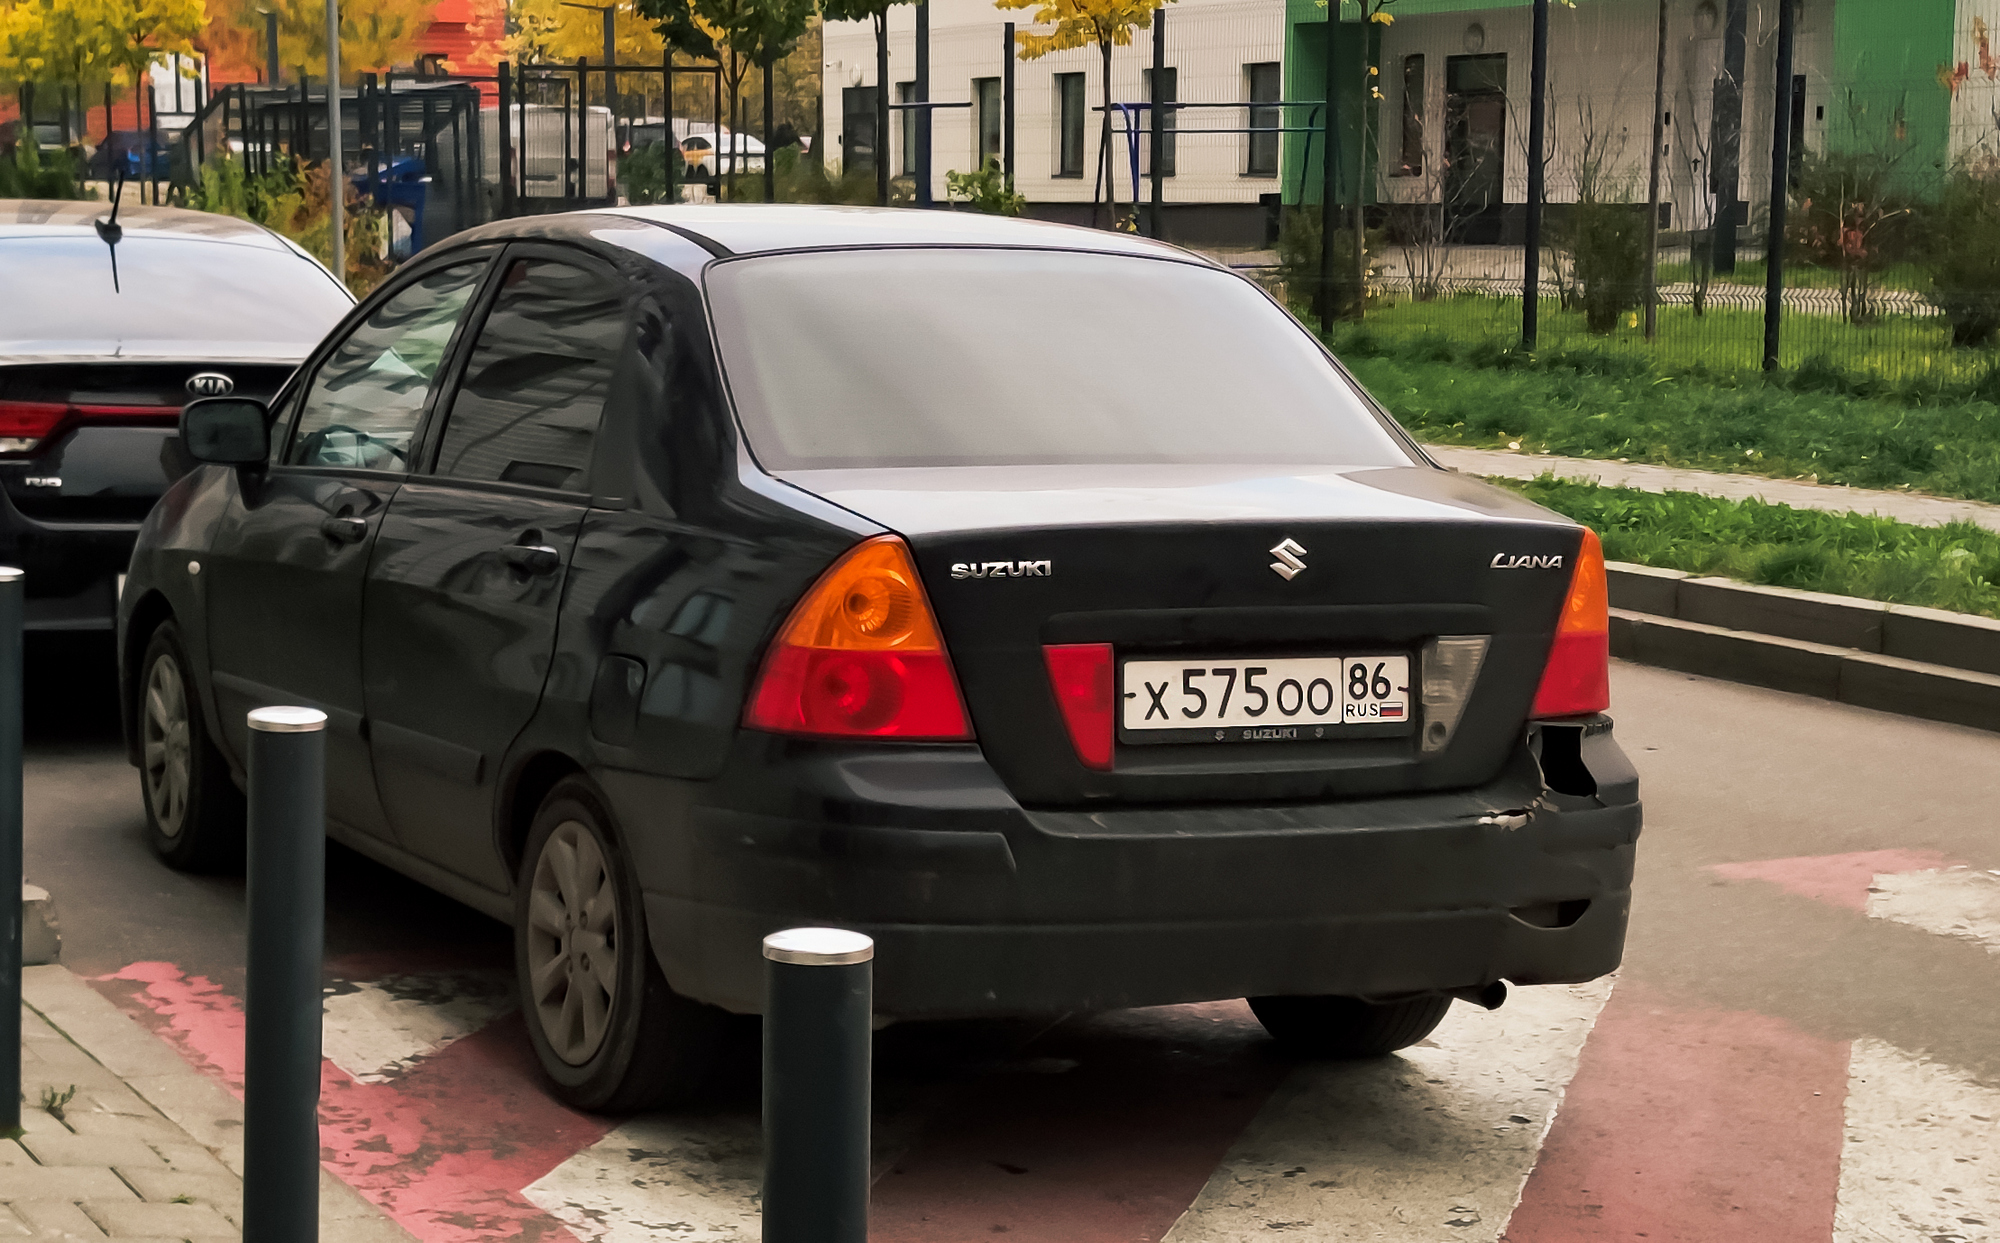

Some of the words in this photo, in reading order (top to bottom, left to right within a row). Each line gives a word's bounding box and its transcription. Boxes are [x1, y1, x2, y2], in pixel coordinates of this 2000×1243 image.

[193, 378, 228, 395] KIA
[1489, 552, 1563, 569] LIANA
[950, 560, 1052, 580] SUZUKI
[1348, 662, 1392, 700] 86
[1346, 703, 1379, 717] RUS
[1242, 728, 1298, 740] SUZUKI
